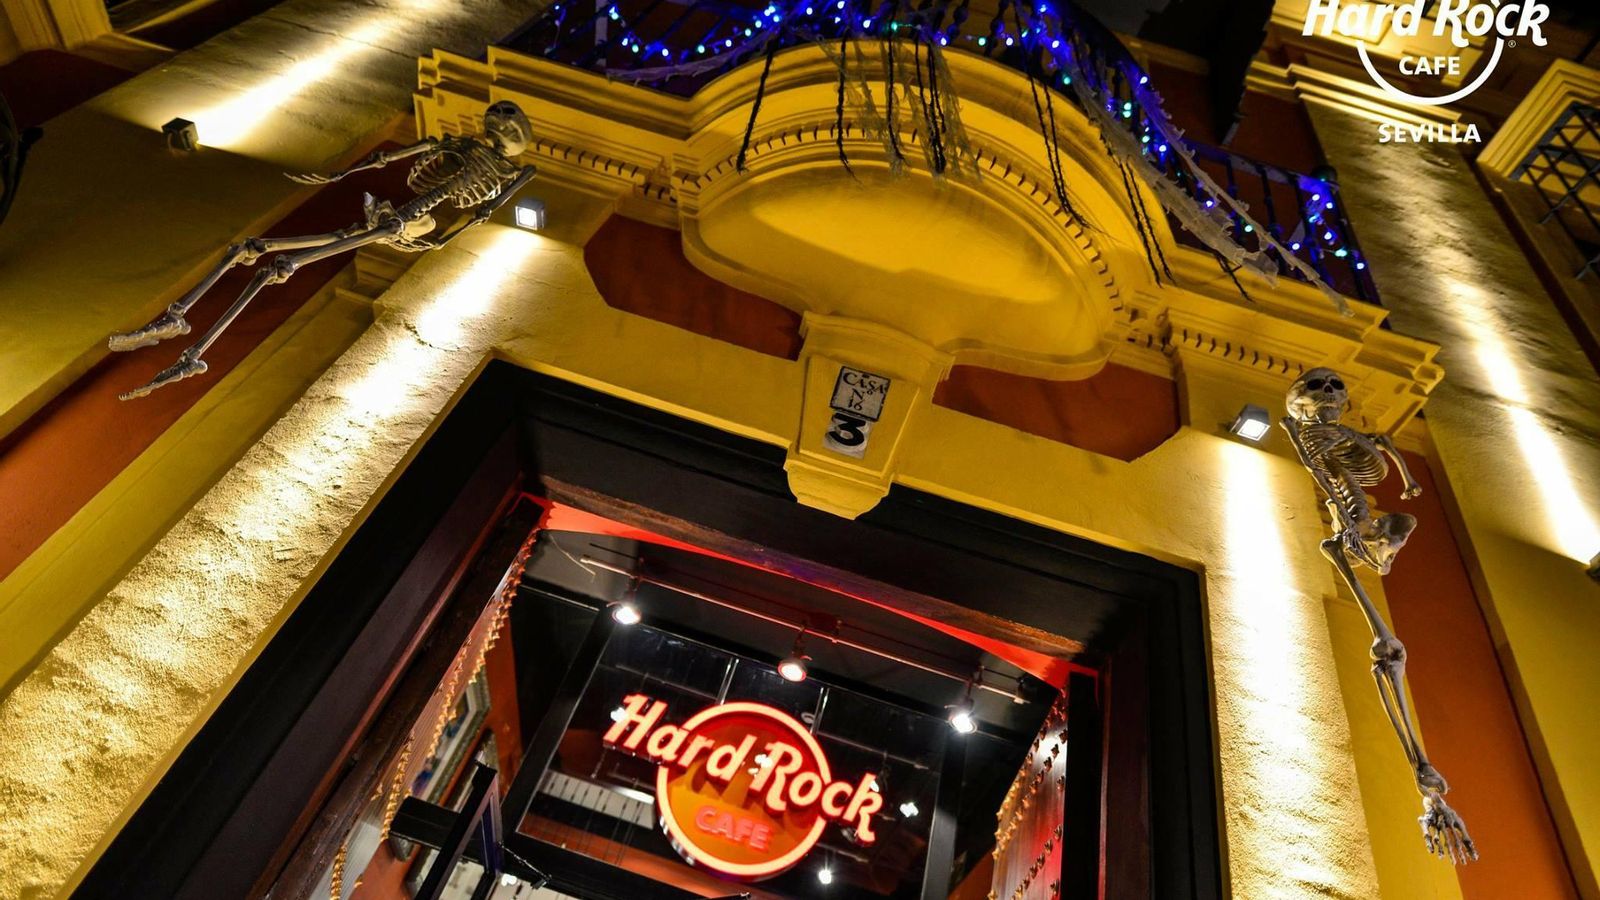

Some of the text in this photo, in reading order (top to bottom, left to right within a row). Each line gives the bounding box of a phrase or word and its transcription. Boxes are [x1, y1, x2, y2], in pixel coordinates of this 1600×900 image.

[843, 372, 887, 393] CASA
[827, 412, 866, 446] 3
[602, 692, 884, 843] Hard Rock
[696, 805, 771, 849] CAFE
